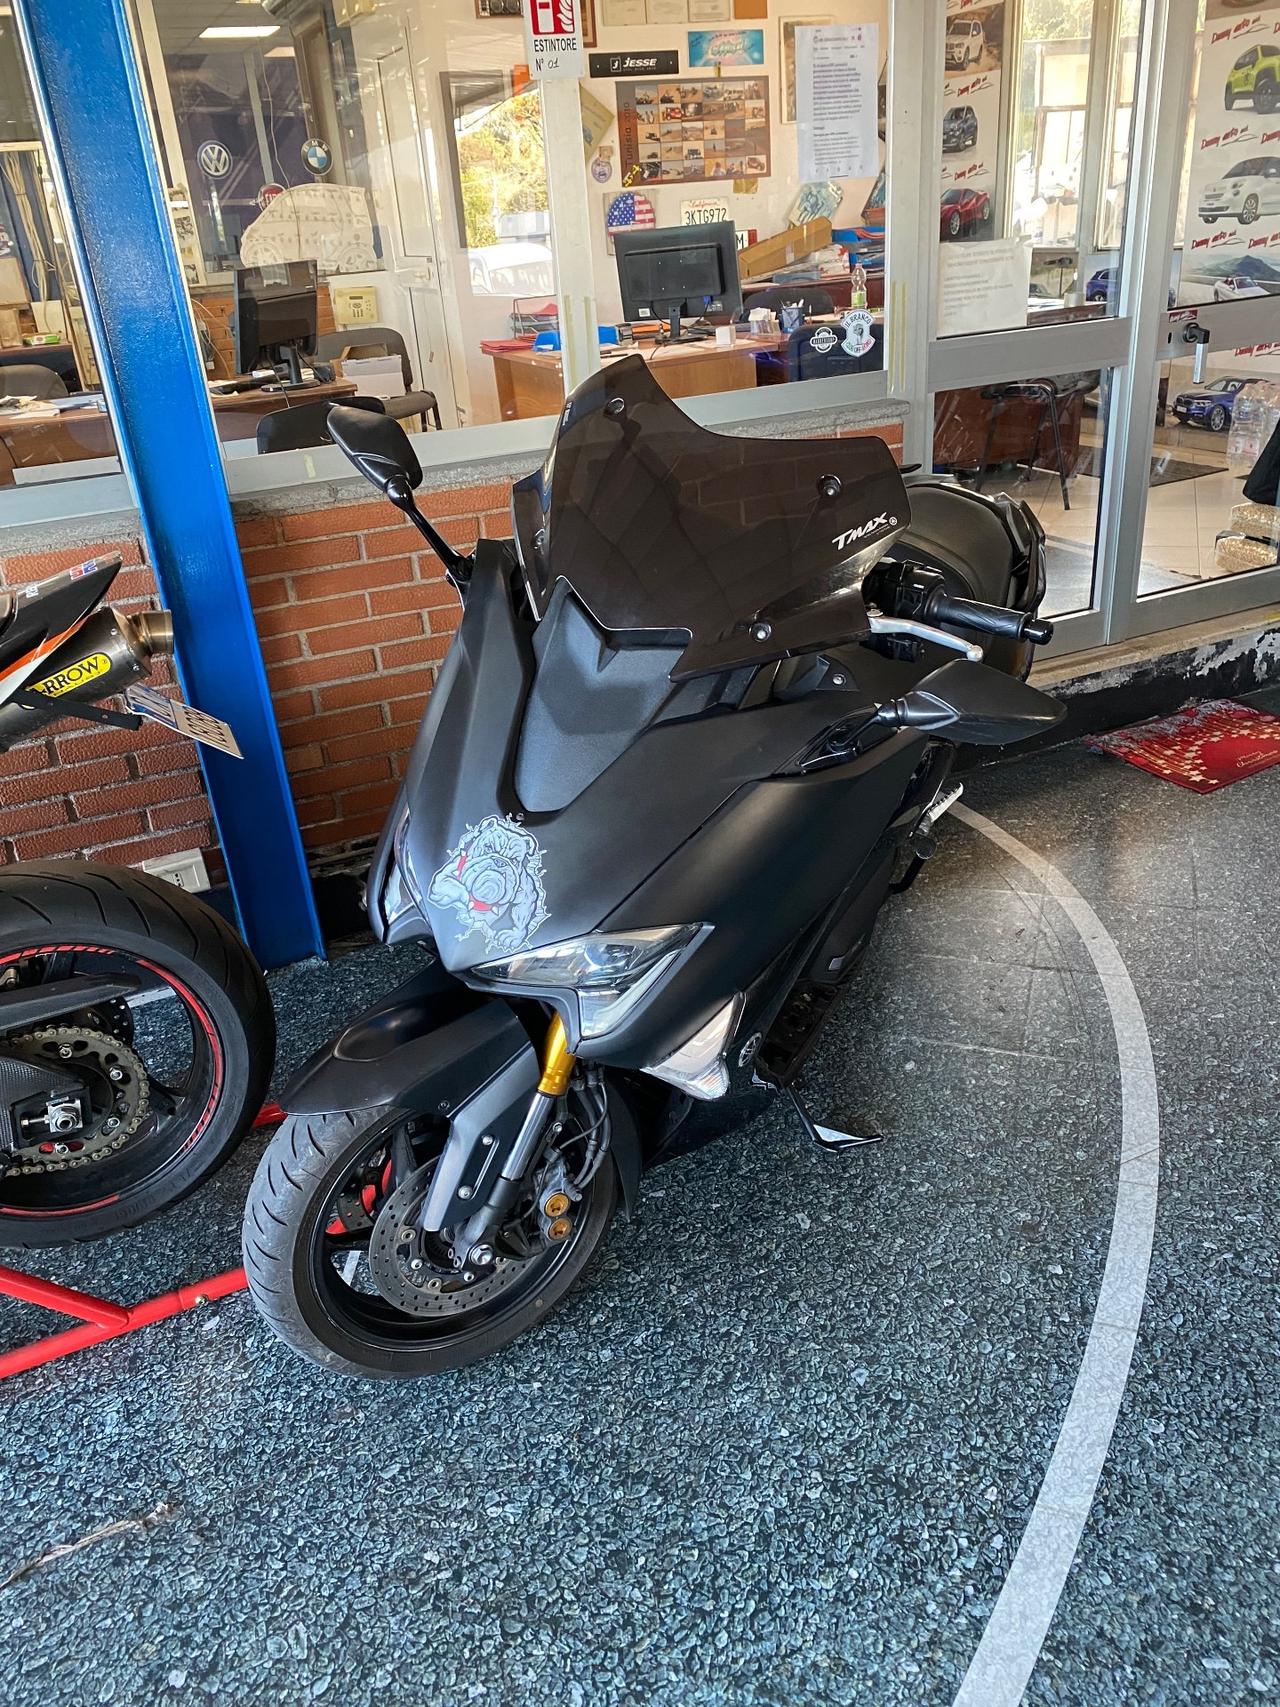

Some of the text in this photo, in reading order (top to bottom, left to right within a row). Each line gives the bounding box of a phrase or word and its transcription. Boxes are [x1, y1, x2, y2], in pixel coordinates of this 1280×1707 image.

[534, 37, 577, 52] ESTINTORE
[624, 127, 634, 169] Tunisia
[685, 207, 727, 226] 3KTG972
[849, 313, 871, 325] BRANCO
[831, 512, 888, 550] TMAX
[37, 656, 100, 696] RROW
